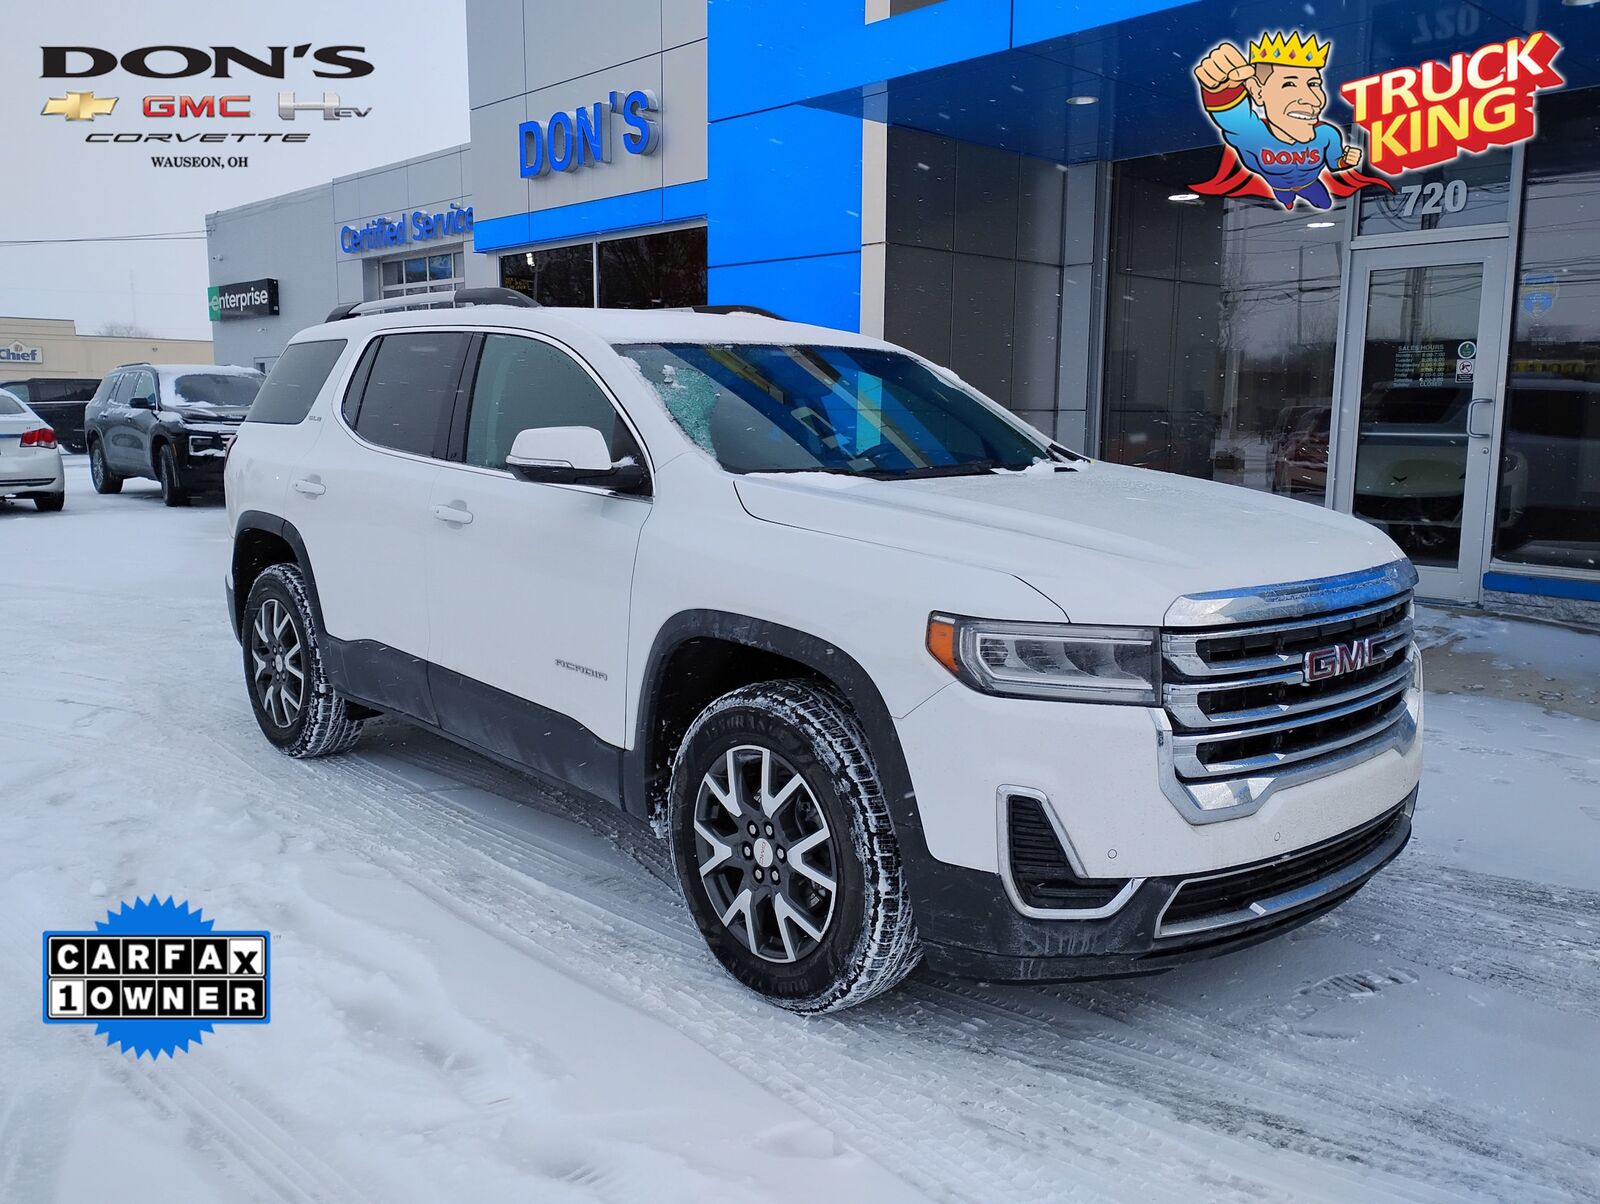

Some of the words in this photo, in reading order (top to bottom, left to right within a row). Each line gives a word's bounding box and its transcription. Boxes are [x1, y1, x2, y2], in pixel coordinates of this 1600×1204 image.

[519, 90, 658, 178] DON'S
[1401, 179, 1468, 217] 720
[341, 213, 406, 253] Certified
[412, 202, 474, 241] Service
[211, 286, 268, 311] enterprise
[1304, 635, 1387, 682] GMC
